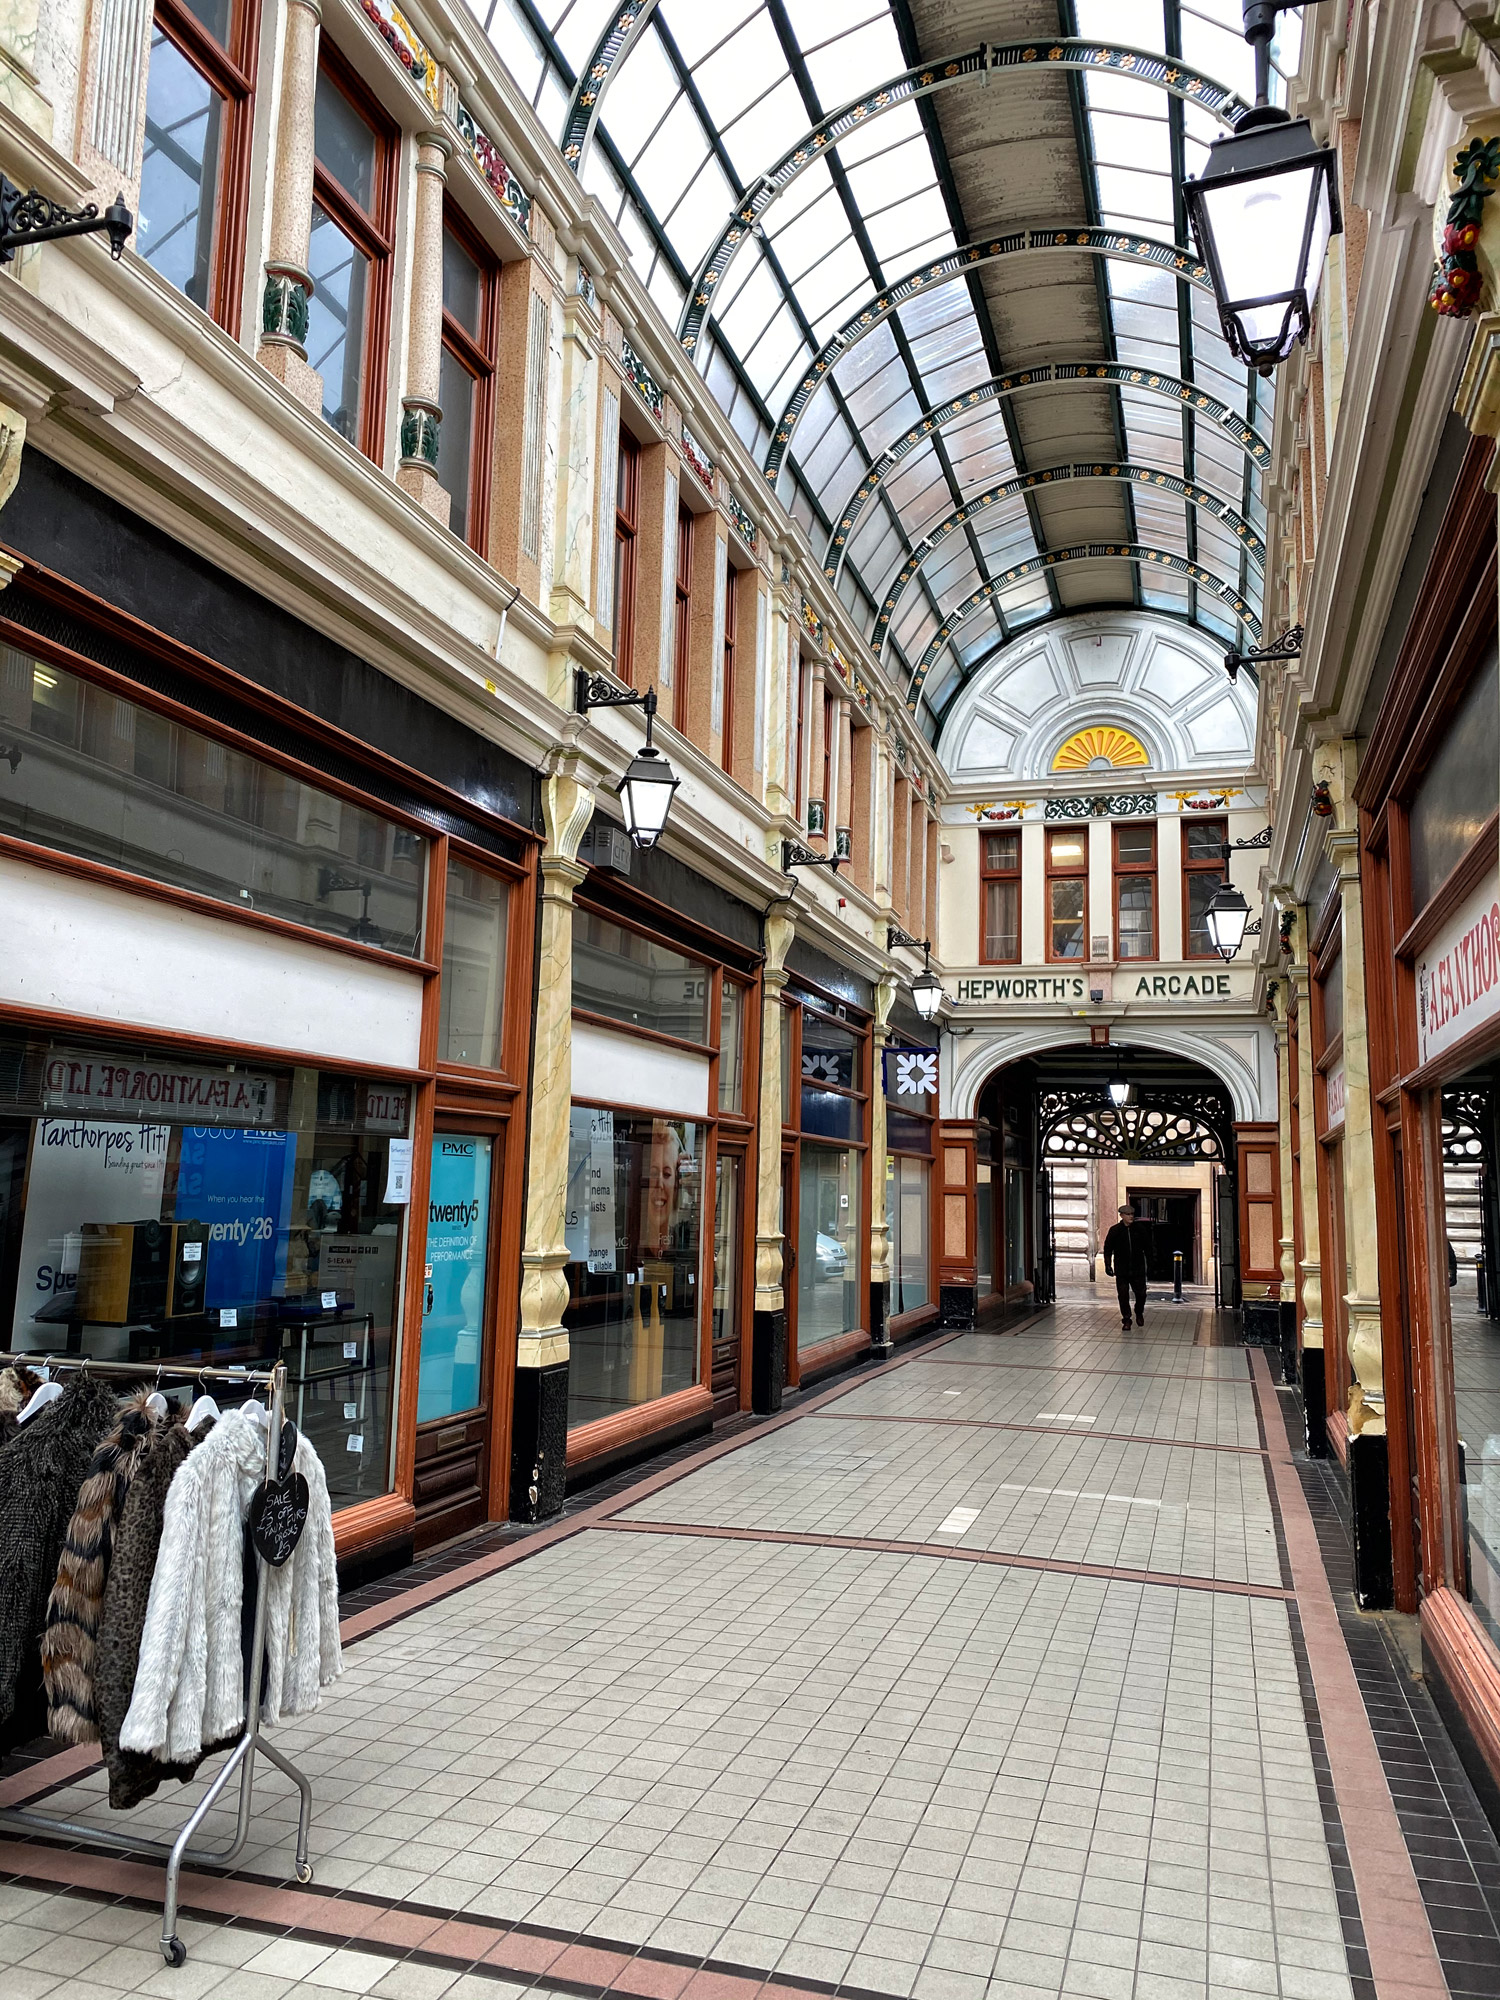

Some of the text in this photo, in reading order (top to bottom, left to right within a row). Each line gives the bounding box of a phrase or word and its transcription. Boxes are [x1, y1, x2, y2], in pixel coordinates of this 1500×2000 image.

[957, 974, 1231, 999] HEPWORTH'S ARCADE
[442, 1142, 474, 1154] PMC
[207, 1194, 265, 1205] When you hear the
[429, 1199, 479, 1228] twenty5
[427, 1235, 478, 1248] THE DEFINITION OF
[431, 1249, 473, 1262] PERFORMANCE
[266, 1489, 292, 1509] SALE
[277, 1504, 294, 1520] OFF
[264, 1508, 307, 1541] FAUX FURS
